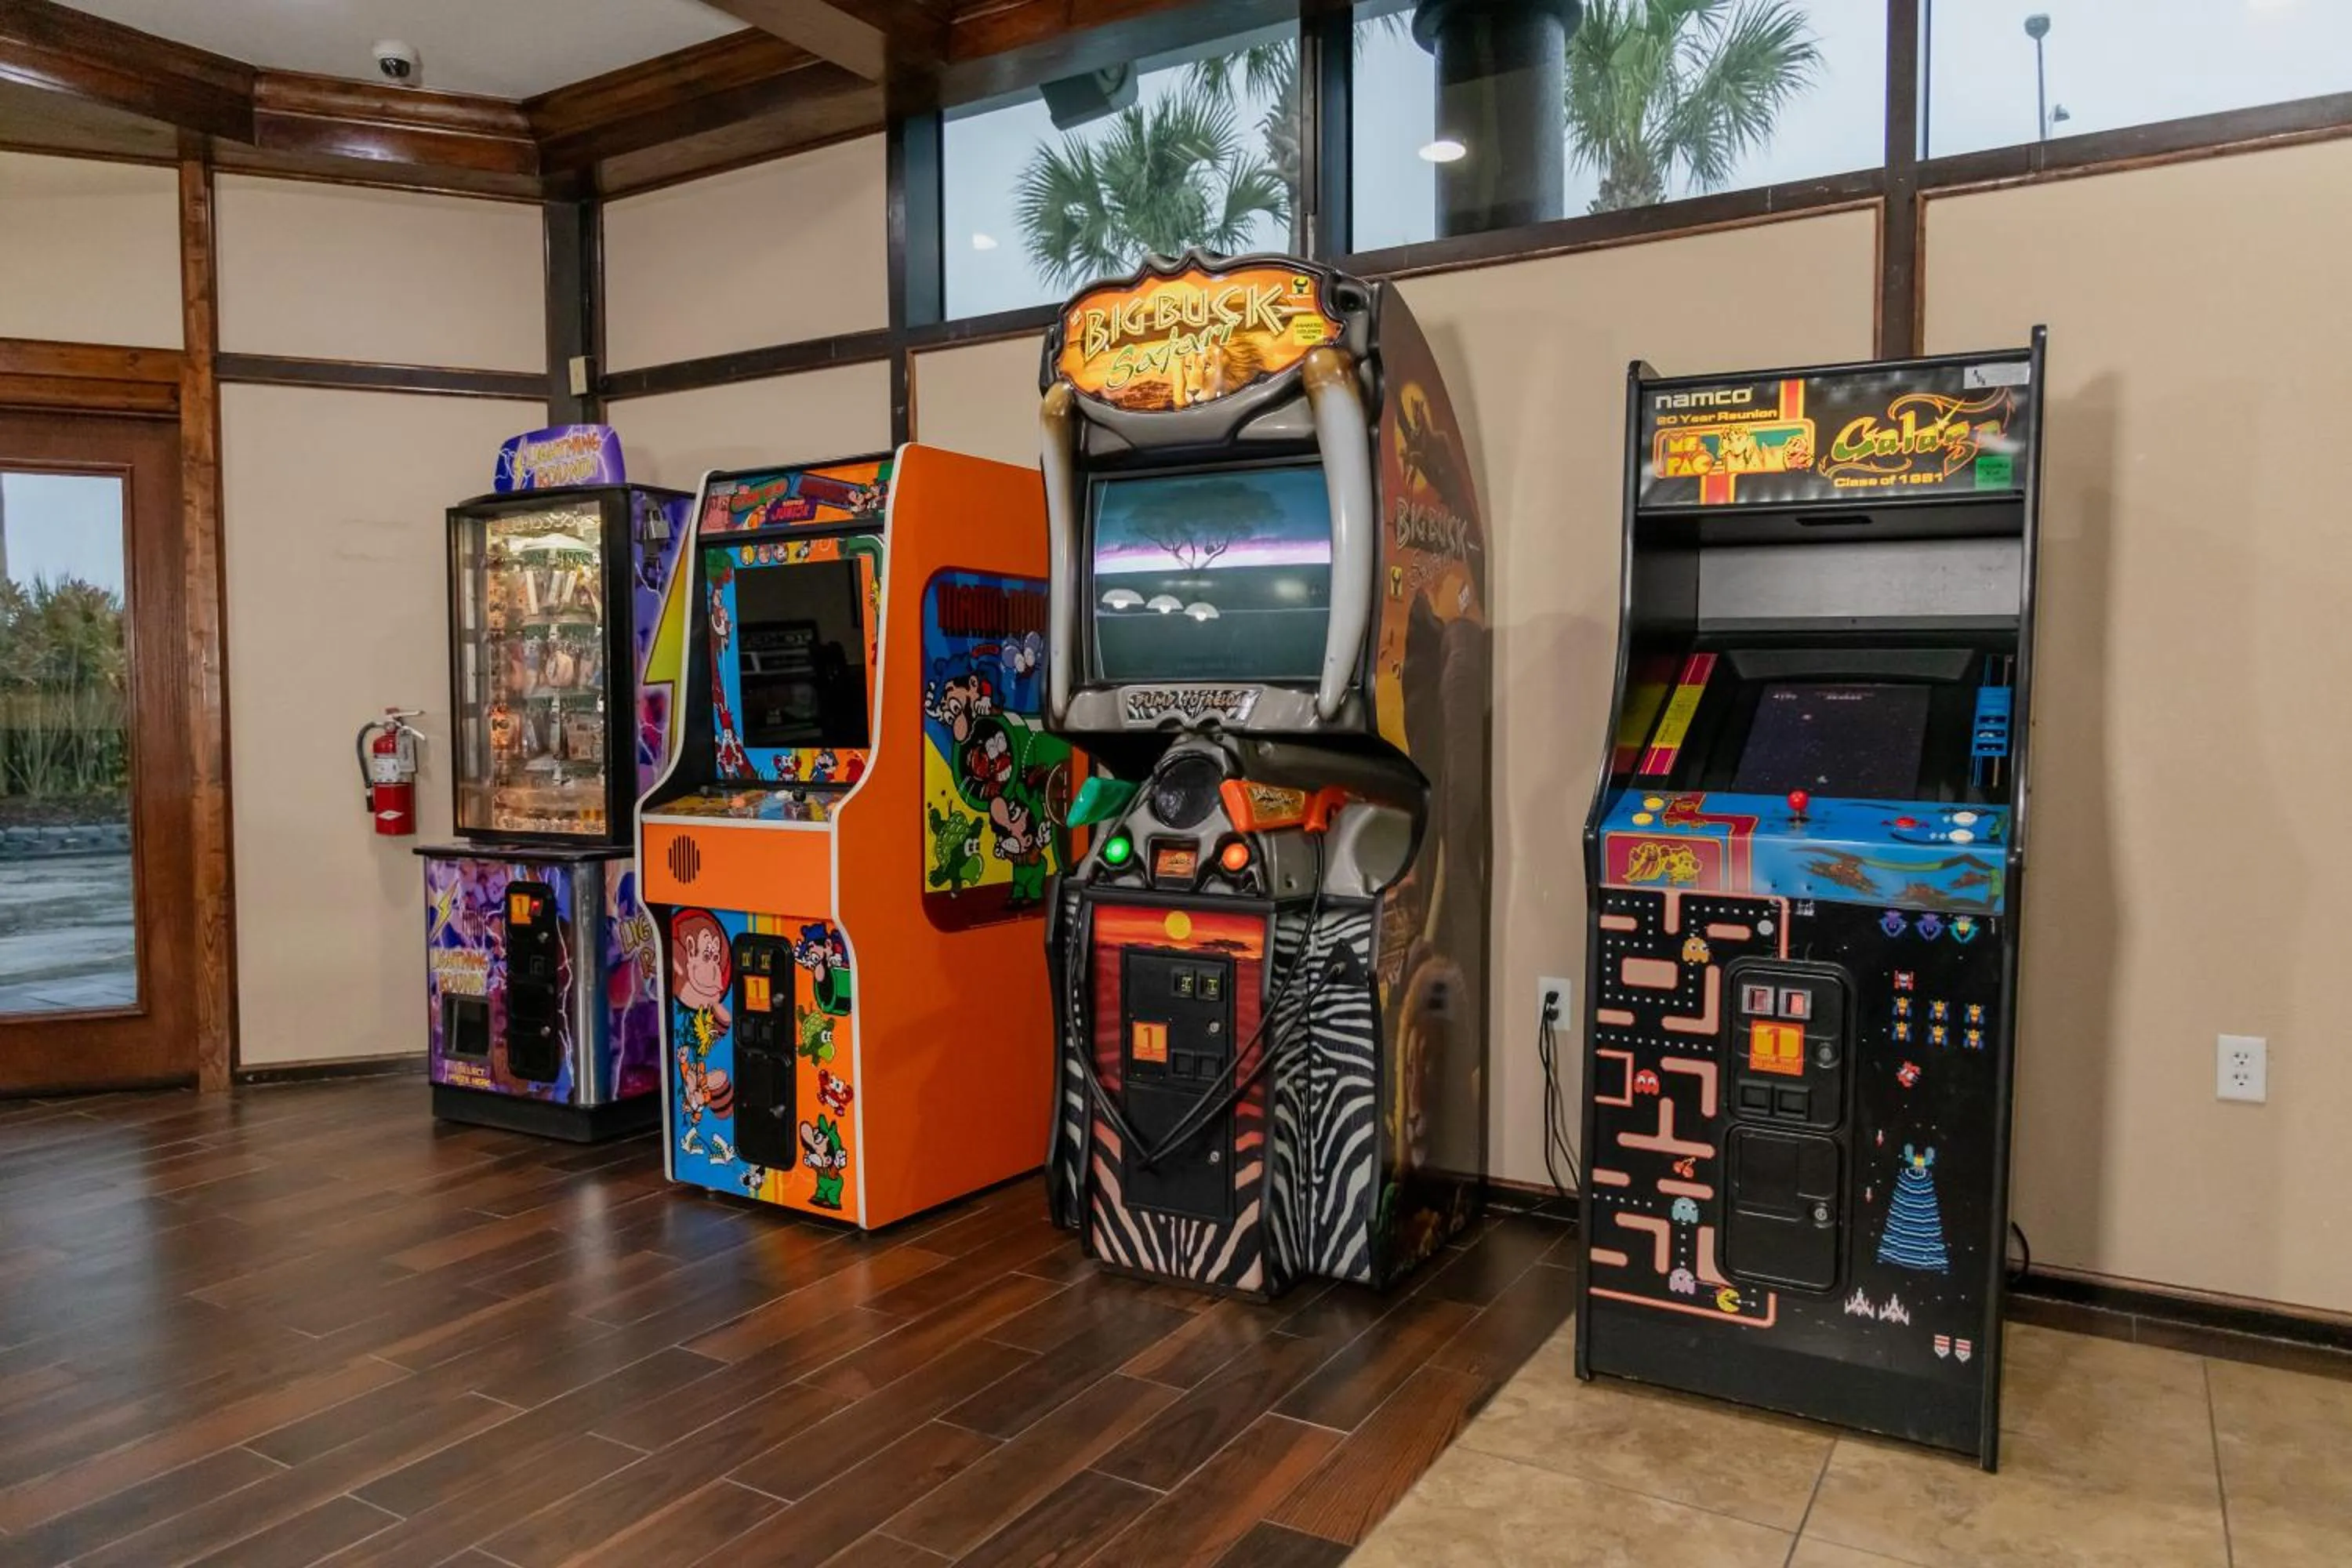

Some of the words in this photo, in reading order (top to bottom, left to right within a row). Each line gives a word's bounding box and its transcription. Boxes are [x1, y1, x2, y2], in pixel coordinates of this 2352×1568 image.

[1083, 298, 1145, 365] BIG
[1154, 282, 1286, 337] BUCK
[1105, 315, 1243, 389] Safari
[1655, 387, 1754, 410] namco
[1680, 412, 1715, 424] Year
[1717, 408, 1778, 421] Reunion
[1833, 476, 1878, 488] Class
[1879, 474, 1896, 486] of
